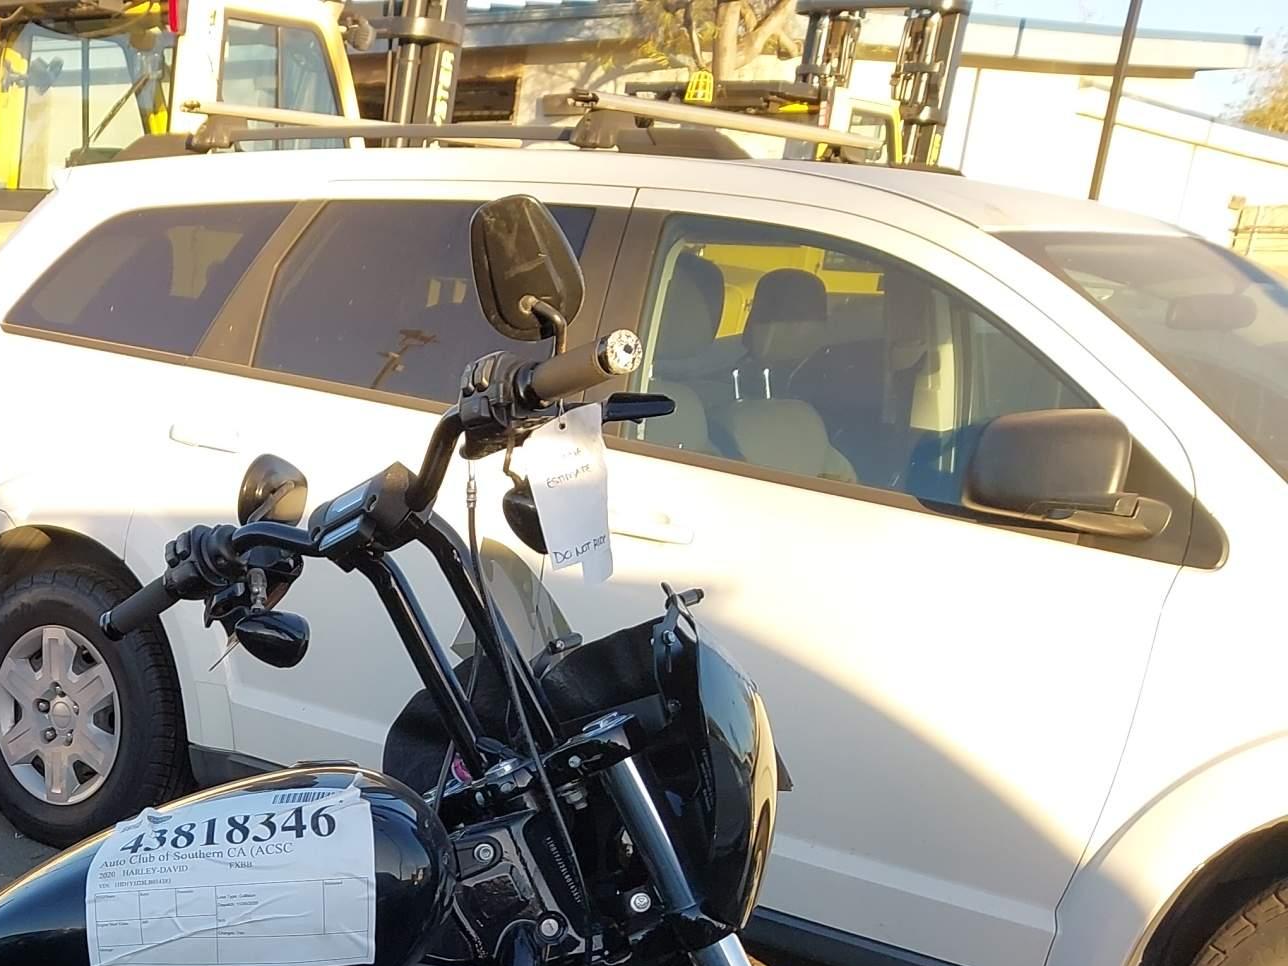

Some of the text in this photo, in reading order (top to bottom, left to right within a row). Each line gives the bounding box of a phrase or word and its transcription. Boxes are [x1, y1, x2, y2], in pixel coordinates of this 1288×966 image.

[552, 550, 573, 565] DO
[575, 541, 592, 557] NOT
[119, 804, 337, 854] 43818346
[99, 841, 295, 869] Auto Club of Southern CA (ACSC
[122, 864, 189, 877] HARLEY-DAVID
